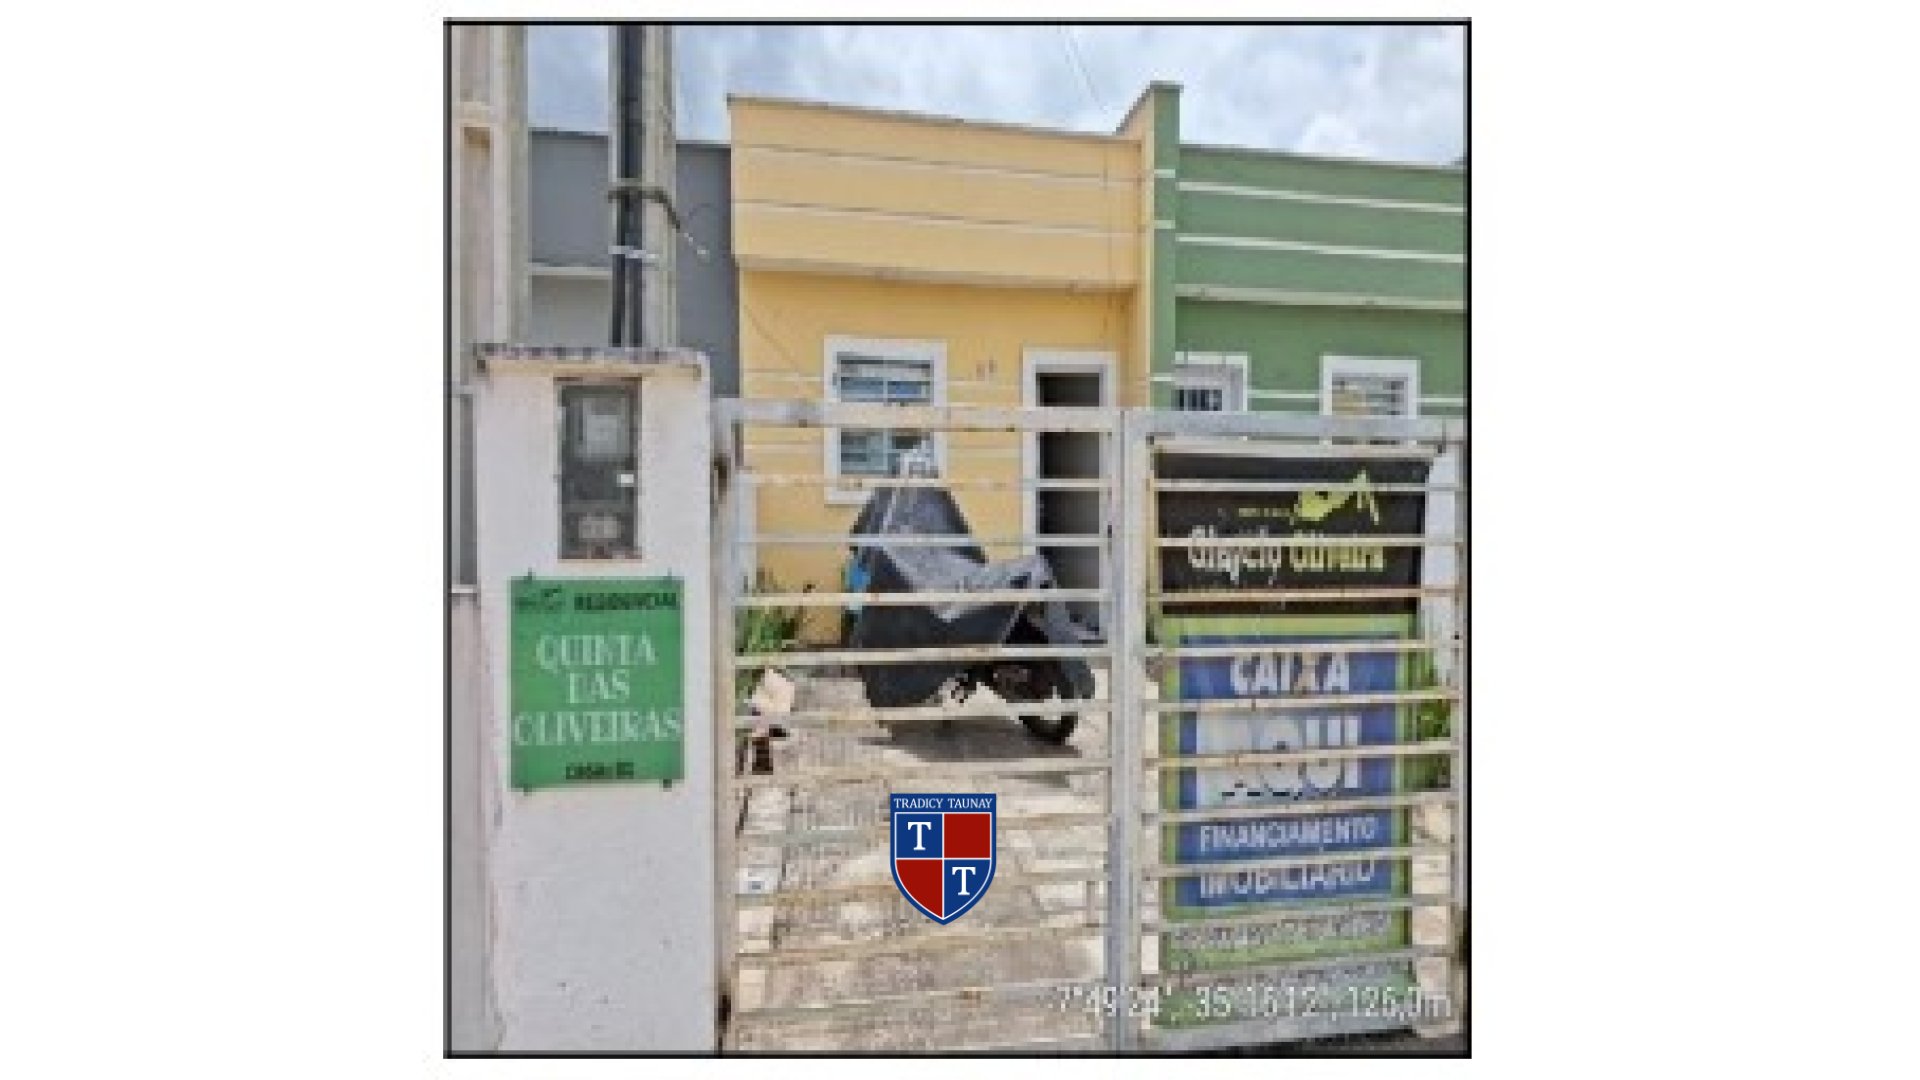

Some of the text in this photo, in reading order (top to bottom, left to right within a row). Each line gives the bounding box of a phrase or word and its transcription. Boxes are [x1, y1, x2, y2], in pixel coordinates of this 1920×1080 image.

[535, 632, 658, 673] QUINTA
[1230, 648, 1351, 695] CAIXA
[567, 668, 631, 704] DAS
[514, 706, 682, 746] OLIVEIRAS
[1199, 815, 1379, 854] FINANCIAMENTO
